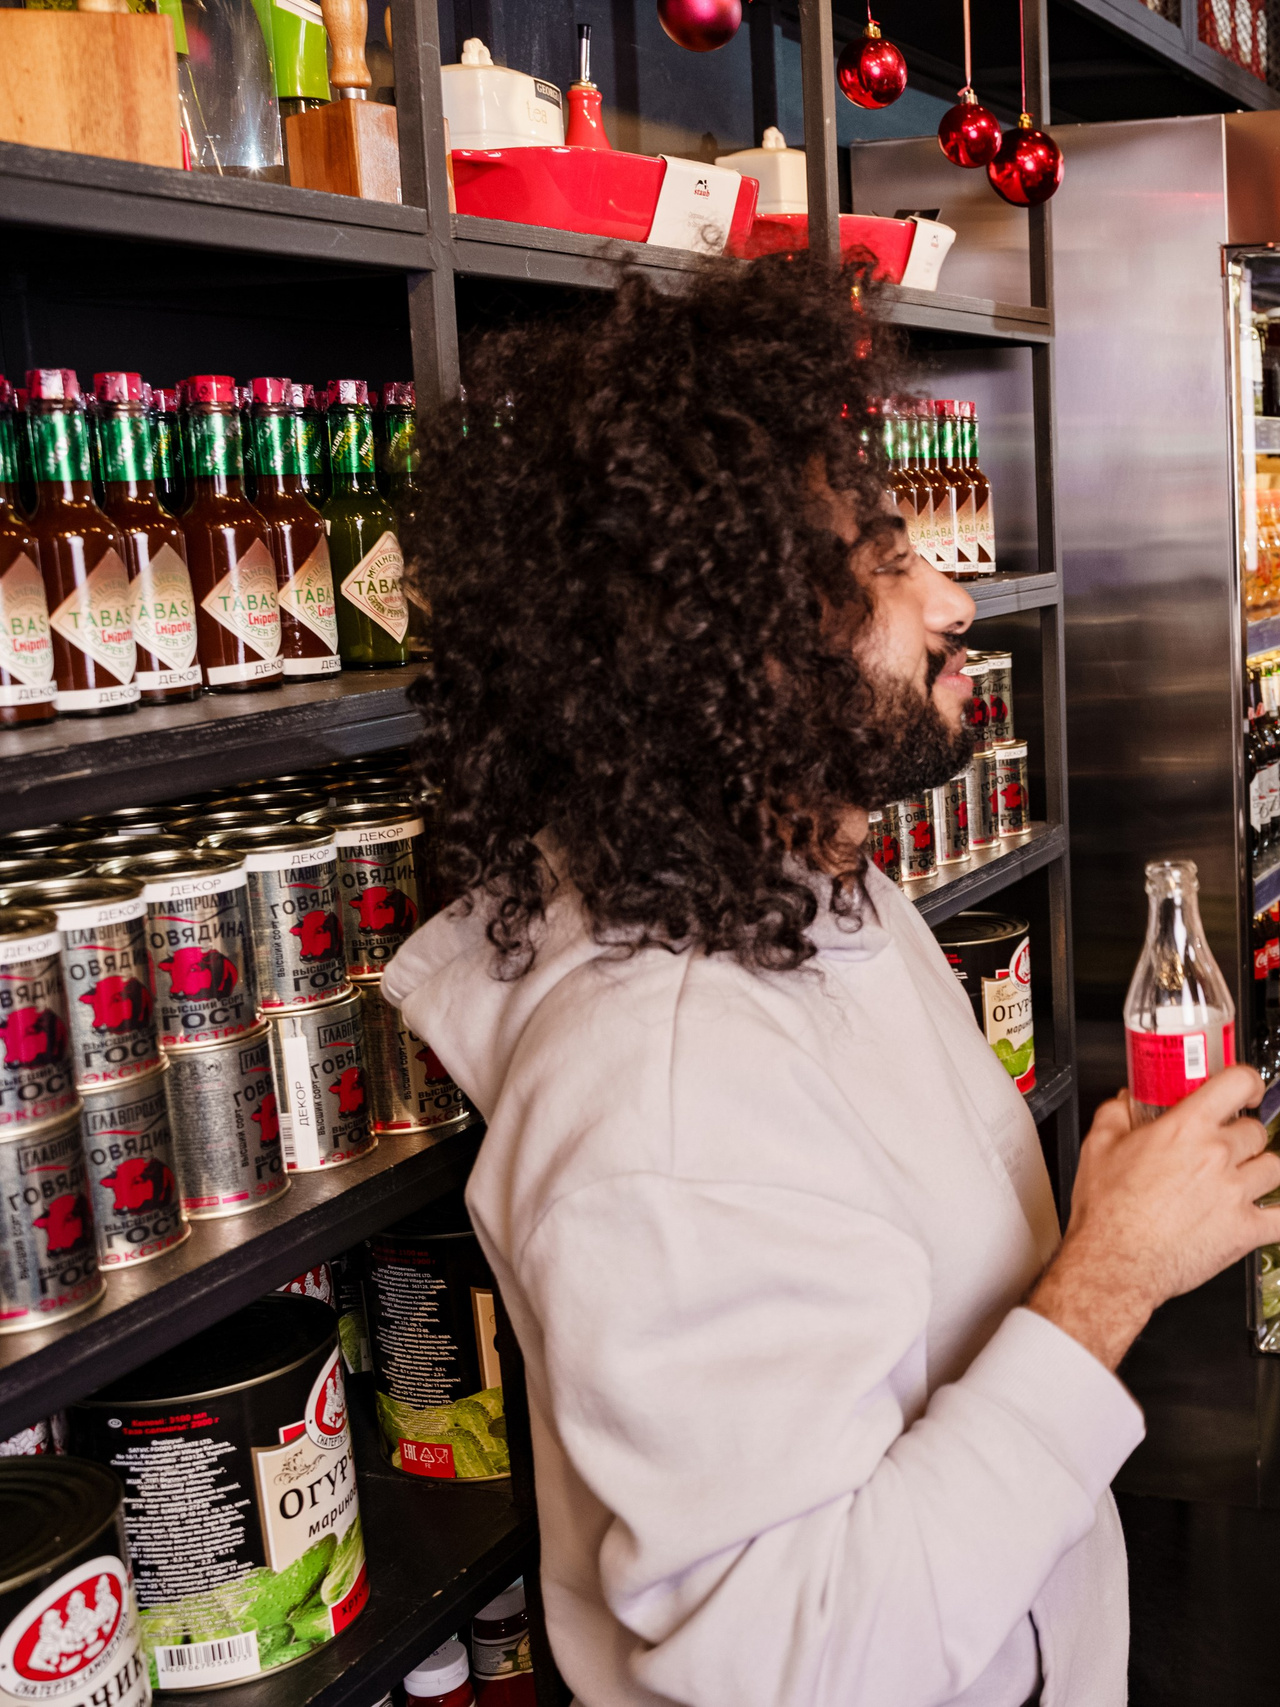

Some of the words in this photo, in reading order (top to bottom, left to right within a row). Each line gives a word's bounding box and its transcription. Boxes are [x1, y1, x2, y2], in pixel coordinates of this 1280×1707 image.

[526, 99, 548, 124] tea
[358, 827, 404, 843] ДЕКОР
[291, 848, 331, 866] ДЕКОР
[170, 878, 222, 897] ДЕКОР
[162, 1002, 245, 1031] ГОСТ
[299, 1080, 310, 1127] ДЕКОР
